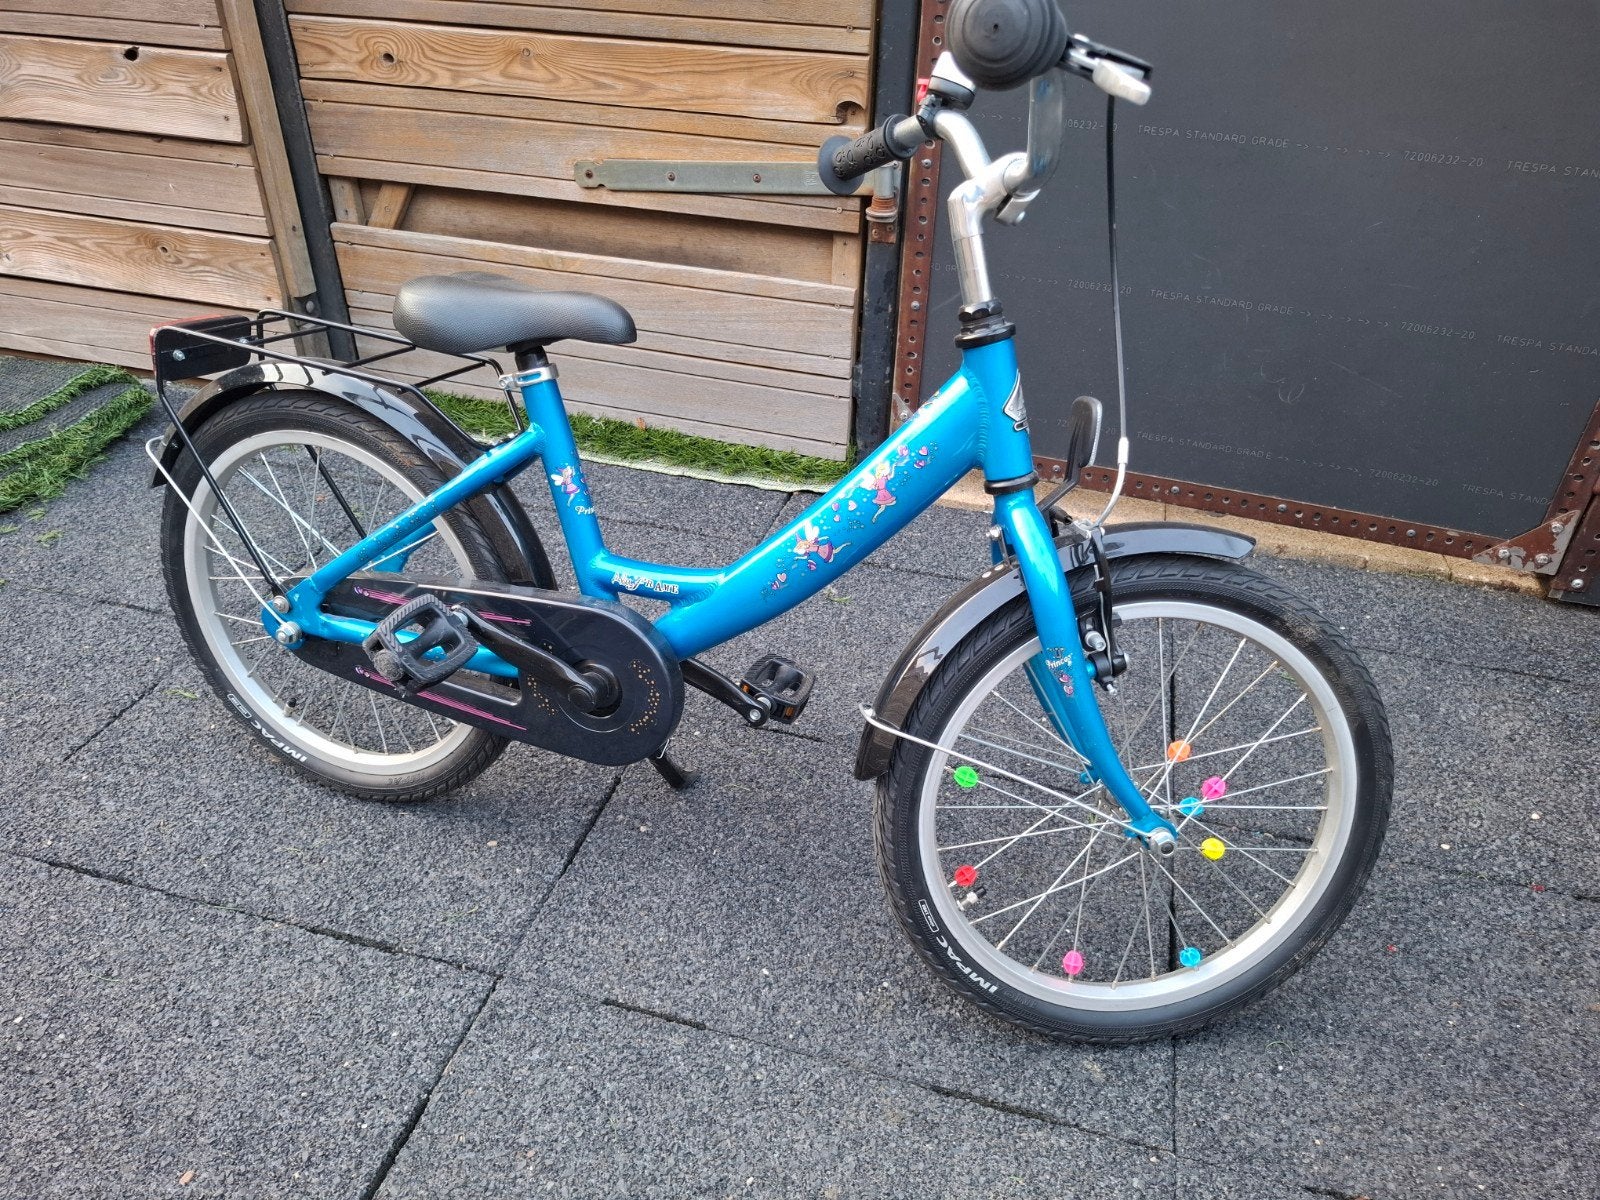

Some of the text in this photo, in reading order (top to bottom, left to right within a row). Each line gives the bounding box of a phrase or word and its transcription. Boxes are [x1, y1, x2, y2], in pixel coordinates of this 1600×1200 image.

[1138, 124, 1180, 137] TRESPA
[1186, 129, 1247, 145] STANDARD
[1251, 136, 1290, 149] GRADE
[1403, 150, 1484, 167] 72006232-20
[1506, 160, 1557, 173] TRESPA
[1068, 279, 1600, 356] 7200623220 TRESPA STANDARD GRADE 72006232-20 TRESPA STANDA
[1136, 430, 1175, 444] TRESPA
[1179, 437, 1232, 453] STANDARD
[1236, 448, 1272, 461] GRADE
[1369, 468, 1439, 487] 72006232-20
[1461, 483, 1504, 498] TRESPA
[251, 720, 307, 762] IMPAC
[935, 934, 999, 994] IMPAC
